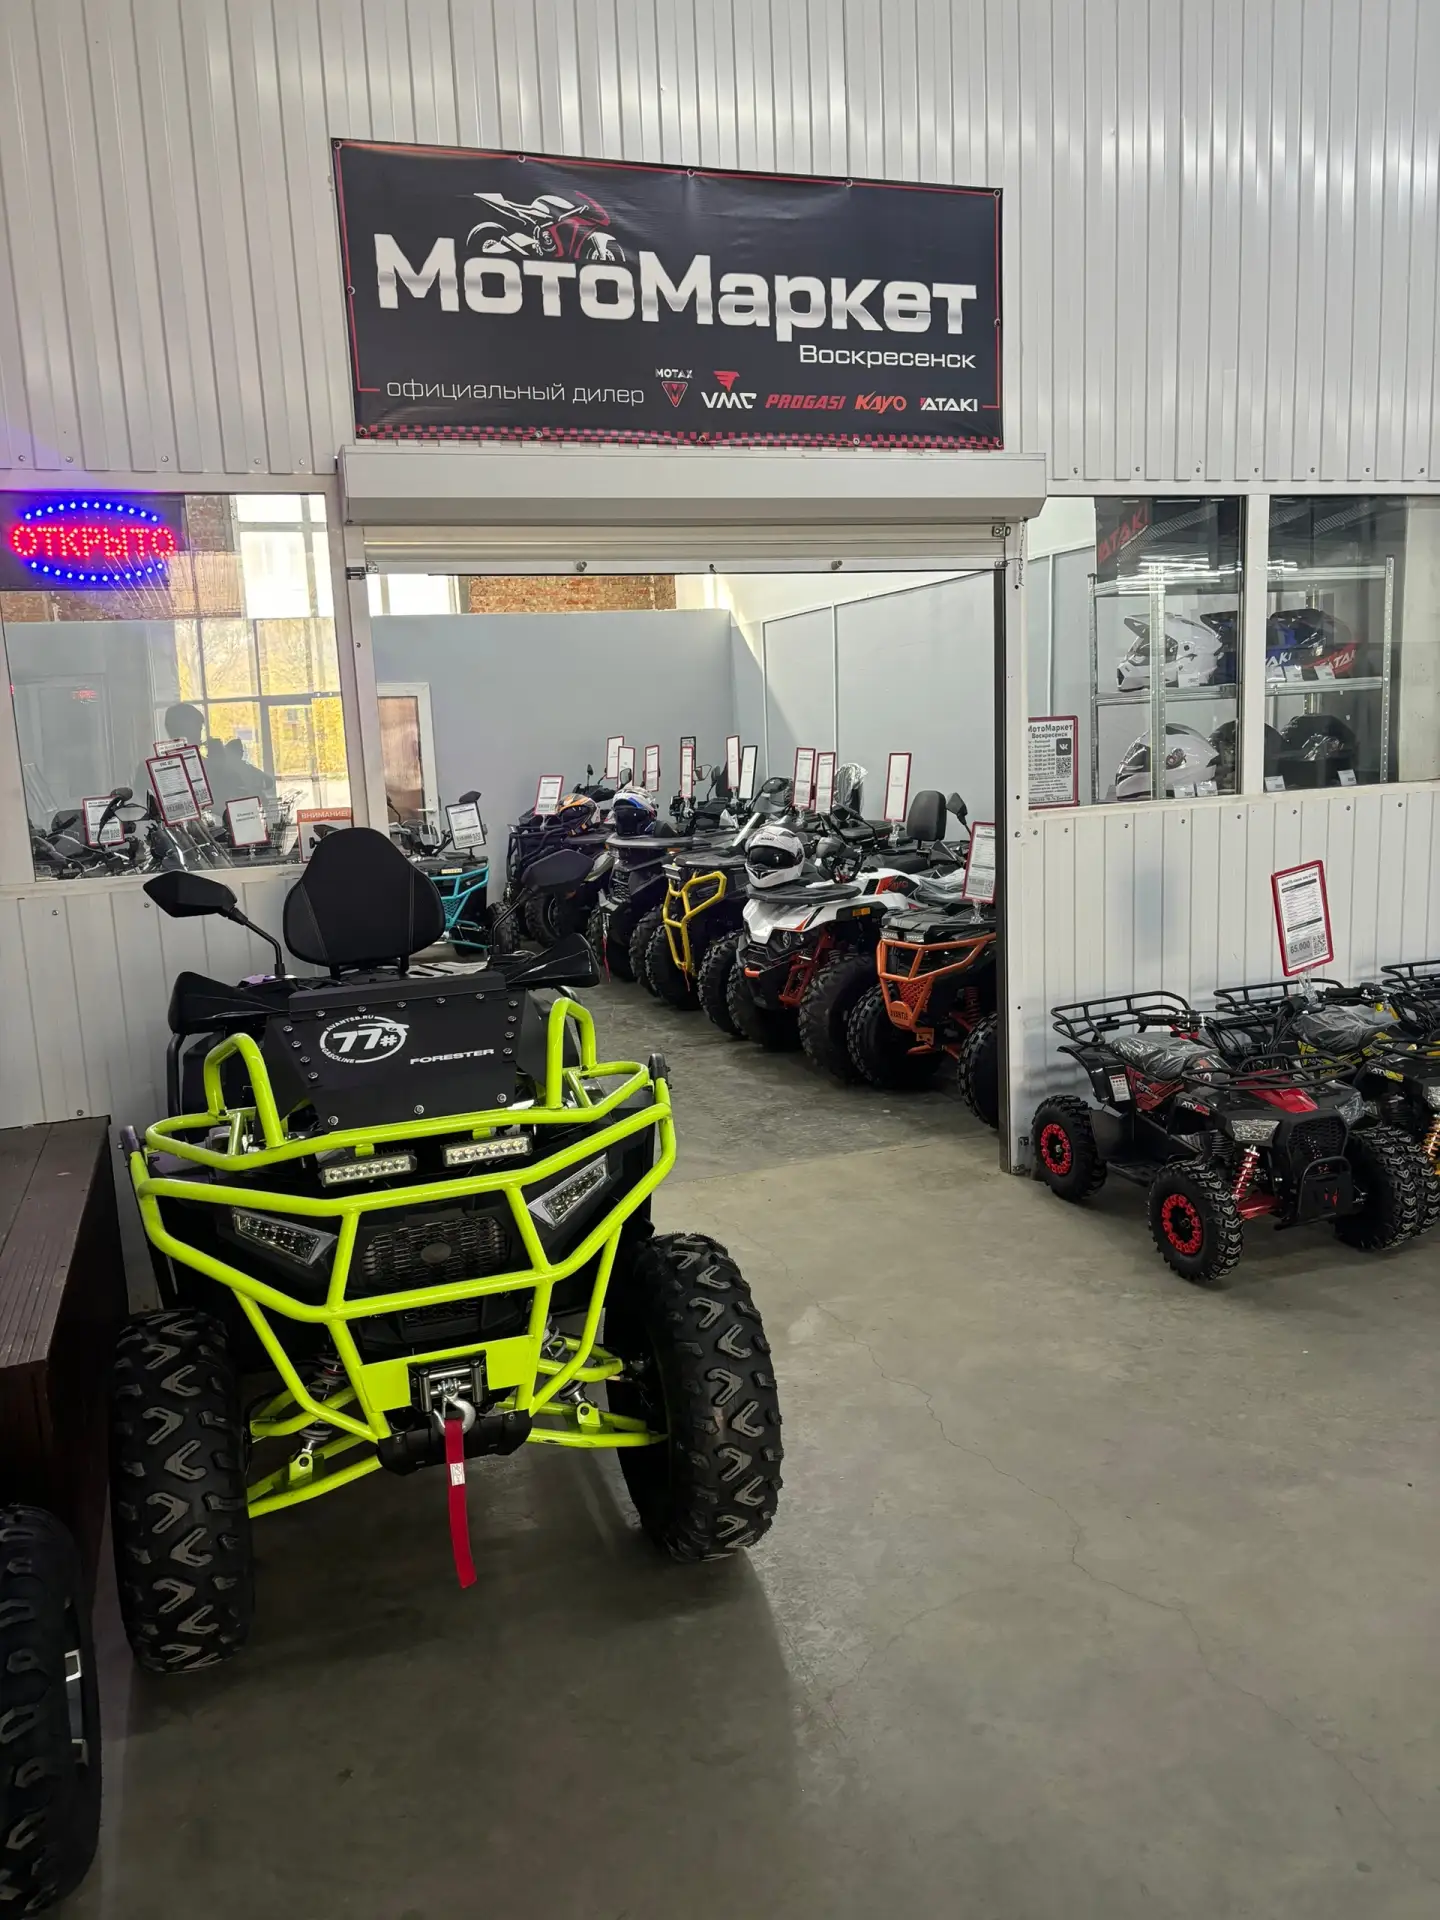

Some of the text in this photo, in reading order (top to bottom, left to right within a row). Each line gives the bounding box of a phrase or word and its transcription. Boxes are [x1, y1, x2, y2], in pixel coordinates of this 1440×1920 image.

[373, 233, 977, 341] МотоМаркет
[799, 344, 976, 369] Воскресенск
[655, 367, 693, 379] MOTAX
[386, 378, 645, 405] официальный дилер
[700, 391, 757, 409] VMC
[764, 393, 846, 410] PROGASI
[921, 397, 978, 412] ATAKI
[13, 526, 175, 557] ОТКРЫТО
[409, 1048, 495, 1065] FORESTER
